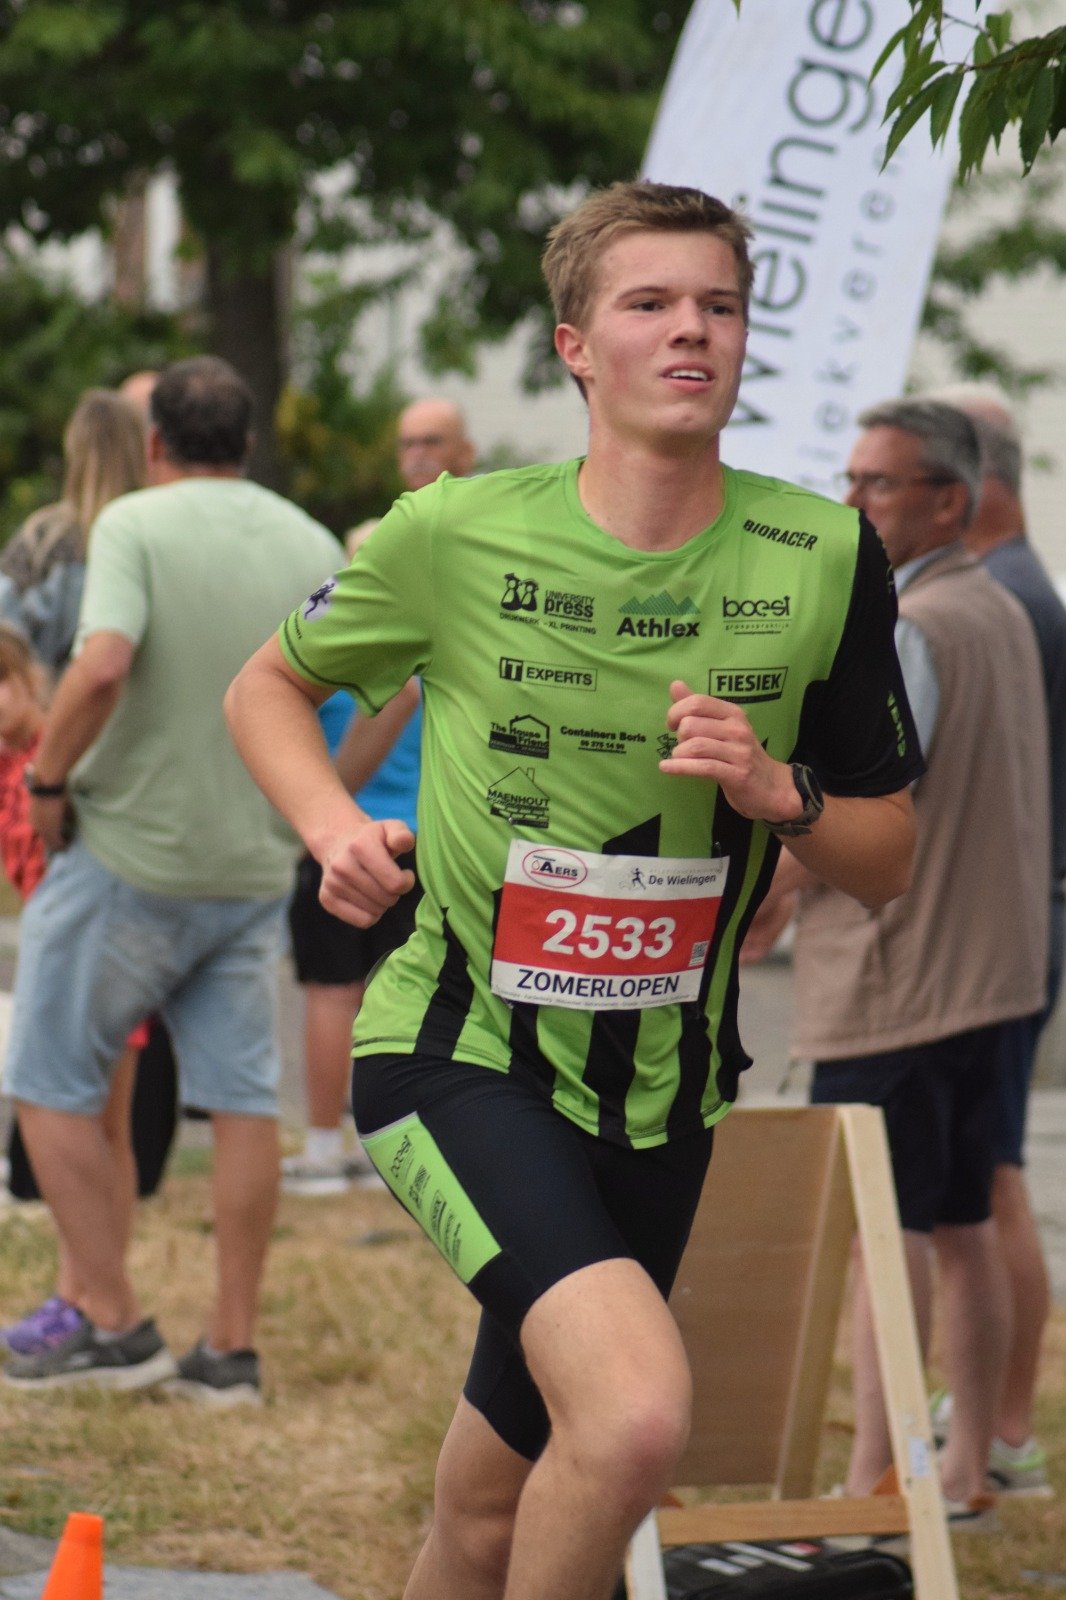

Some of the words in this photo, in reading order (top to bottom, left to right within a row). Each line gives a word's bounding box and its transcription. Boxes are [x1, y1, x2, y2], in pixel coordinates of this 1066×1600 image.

[743, 519, 818, 551] BIORACER
[545, 589, 595, 605] UNIVERSITY
[544, 597, 594, 618] press
[560, 622, 597, 635] PRINTING
[616, 616, 700, 638] Athlex
[526, 666, 593, 686] EXPERTS
[716, 673, 782, 692] FIESIEK
[560, 725, 616, 740] Containers
[487, 788, 549, 806] MAENHOUT
[648, 874, 664, 885] De
[667, 874, 717, 886] Wielingen
[542, 908, 676, 960] 2533
[517, 968, 680, 998] ZOMERLOPEN
